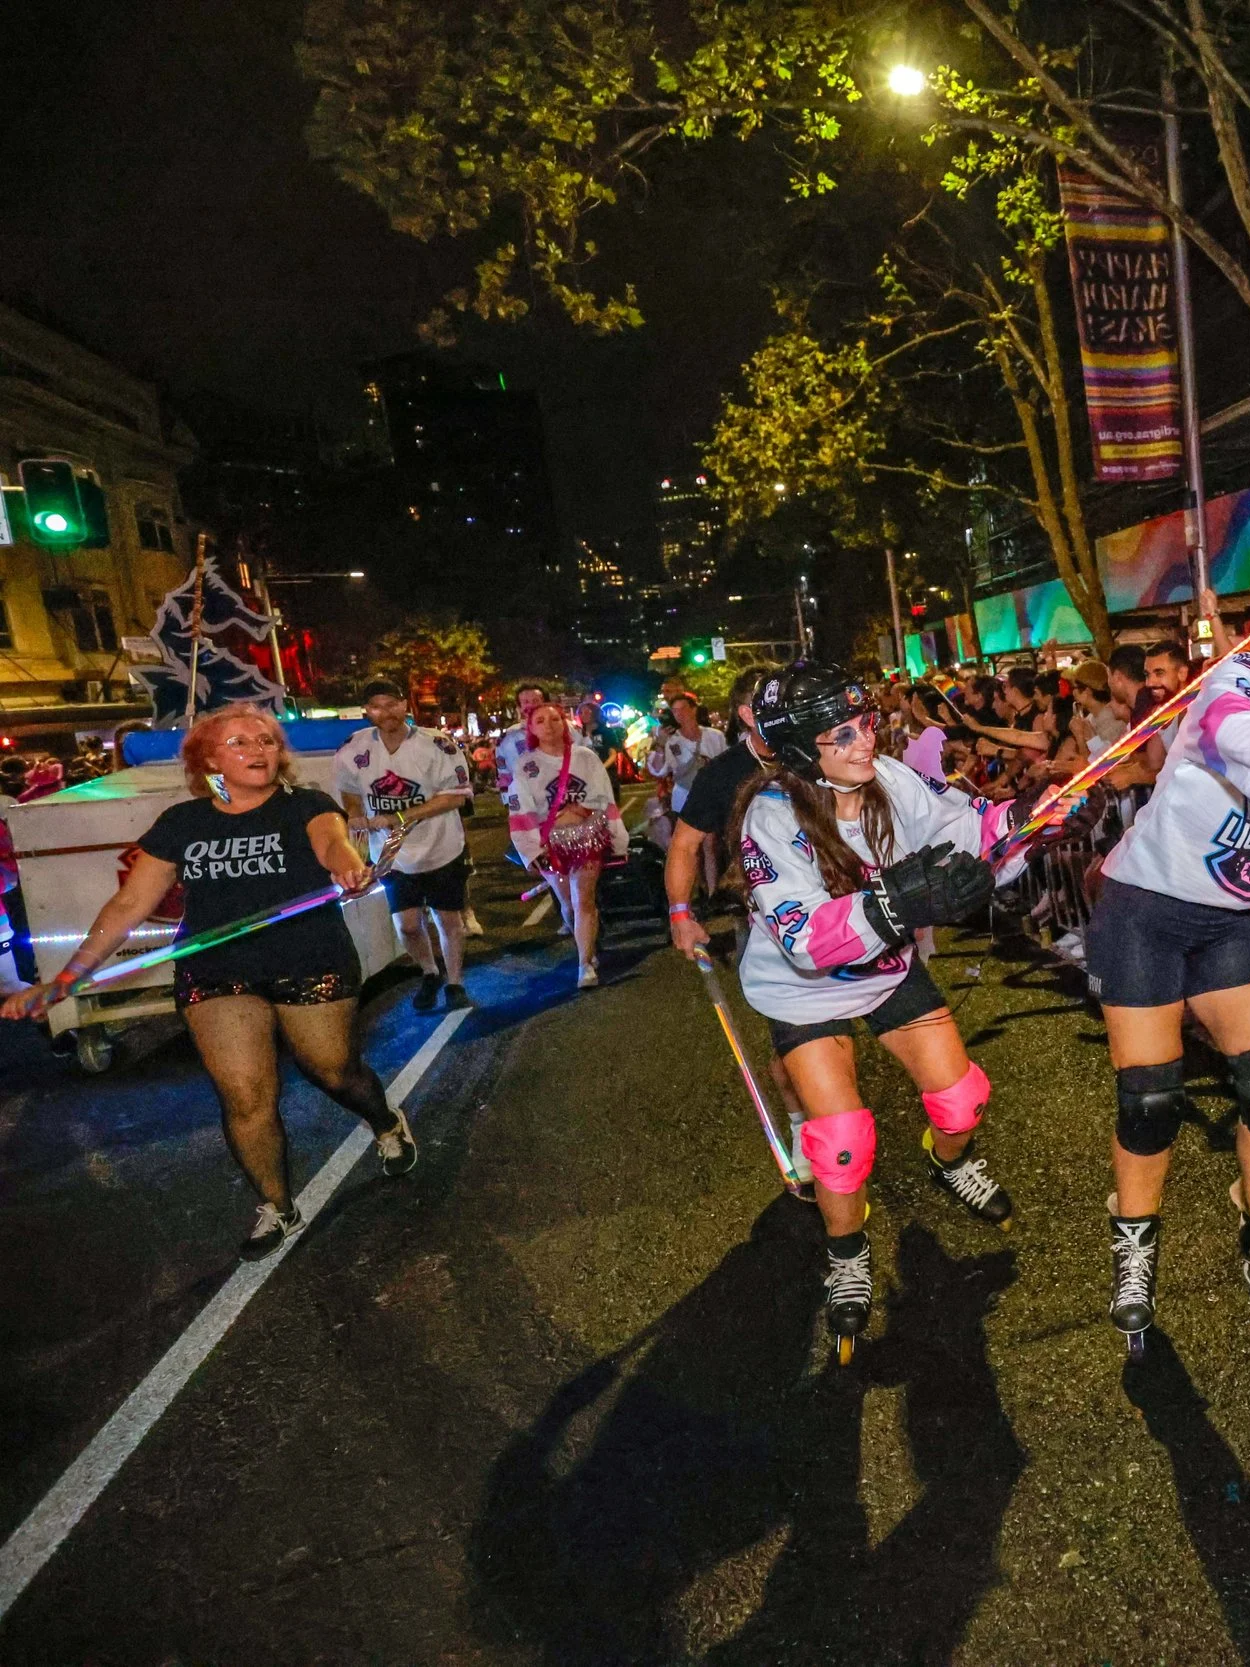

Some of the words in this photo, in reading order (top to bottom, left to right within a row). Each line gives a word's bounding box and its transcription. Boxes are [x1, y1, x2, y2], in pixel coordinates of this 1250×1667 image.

[763, 716, 786, 729] BAUER
[184, 833, 283, 863] QUEER
[183, 862, 203, 880] AS
[209, 854, 287, 880] PUCK!
[869, 868, 905, 937] TRUE
